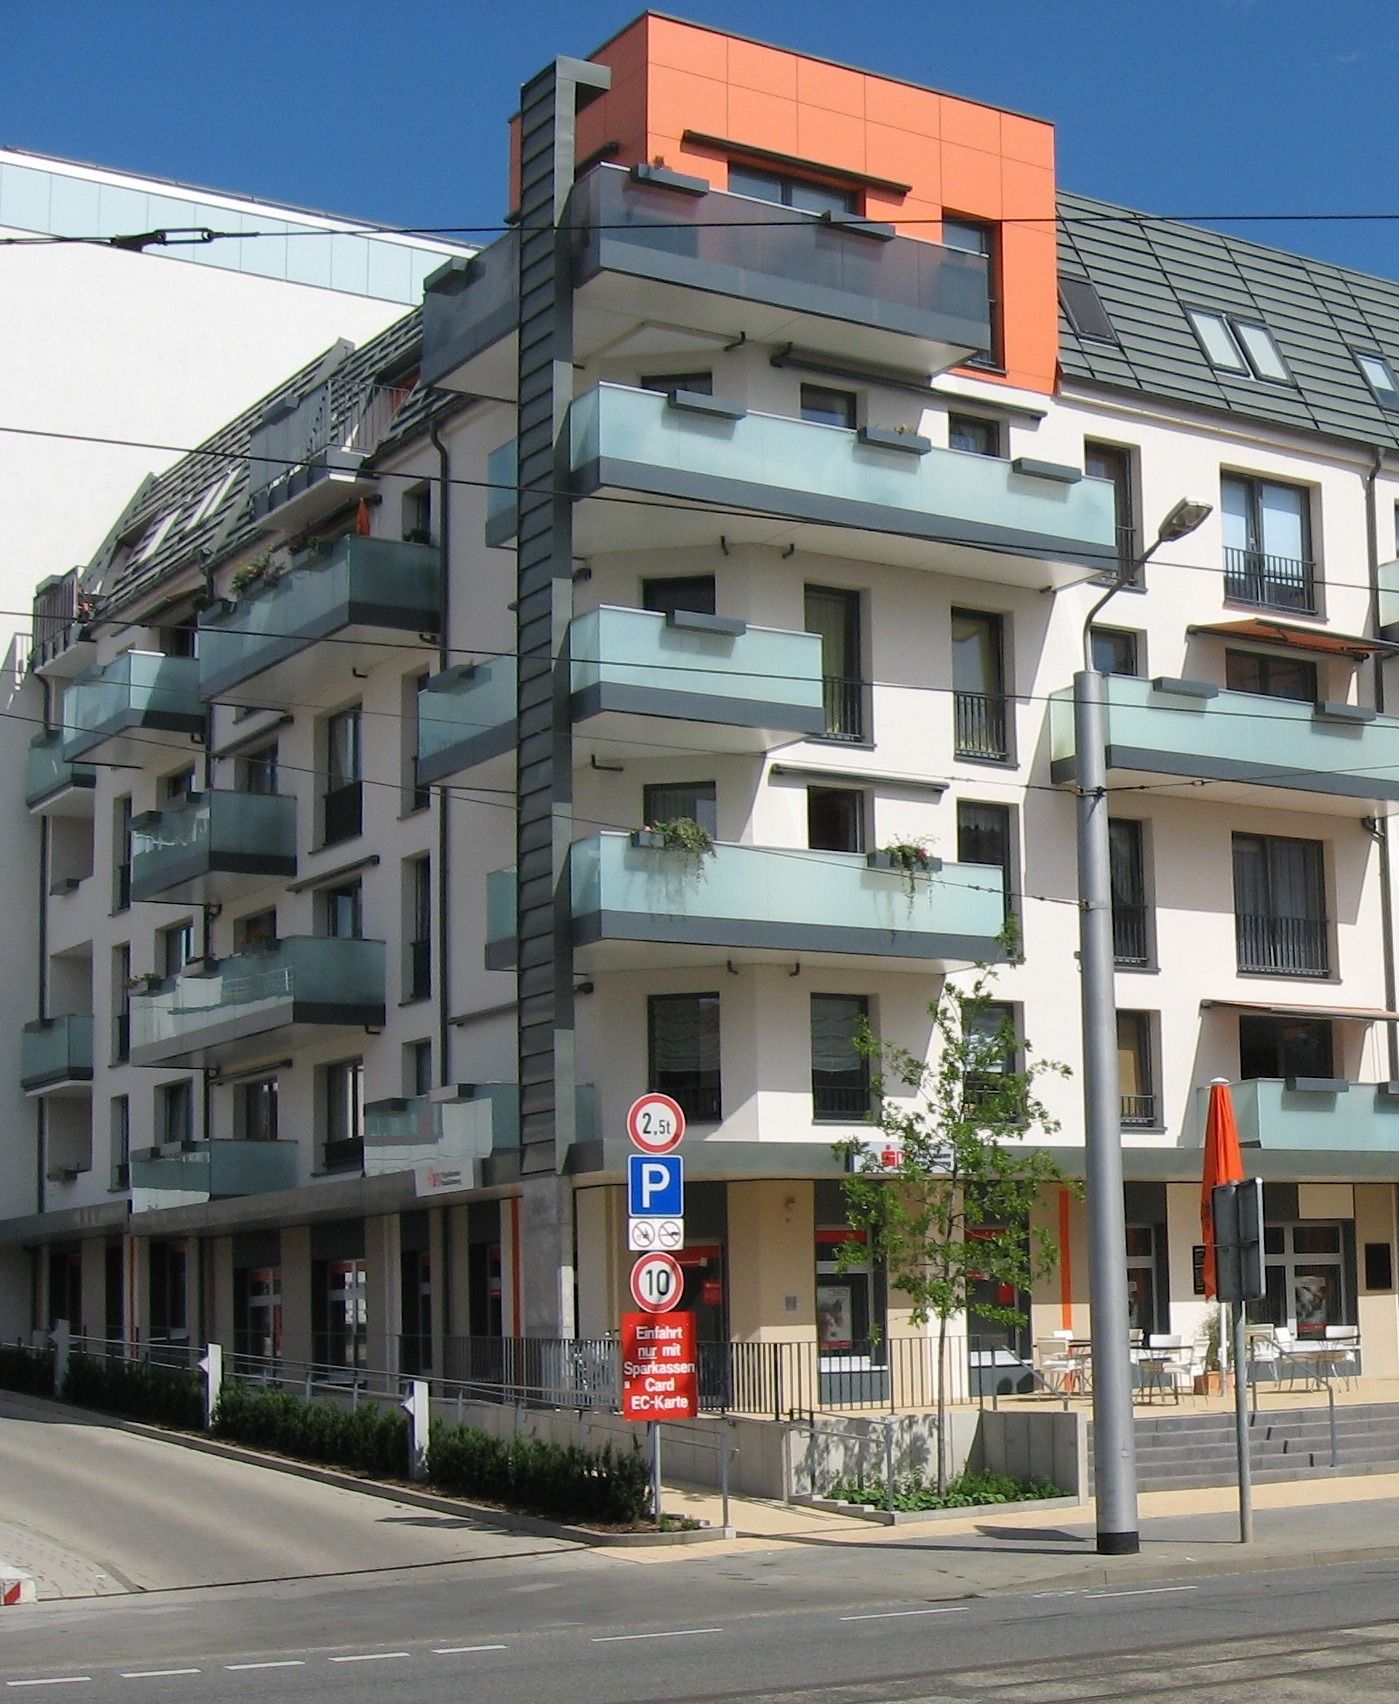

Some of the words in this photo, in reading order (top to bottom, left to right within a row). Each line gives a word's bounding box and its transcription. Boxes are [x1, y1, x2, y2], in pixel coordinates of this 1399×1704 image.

[642, 1112, 671, 1136] 2,5t
[642, 1163, 670, 1208] P
[646, 1269, 670, 1296] 10
[635, 1325, 683, 1340] Einfahrt
[638, 1346, 657, 1357] nur
[661, 1343, 681, 1357] mit
[623, 1361, 696, 1378] Sparkassen
[644, 1377, 675, 1392] Card
[631, 1395, 689, 1410] EC-Karte
